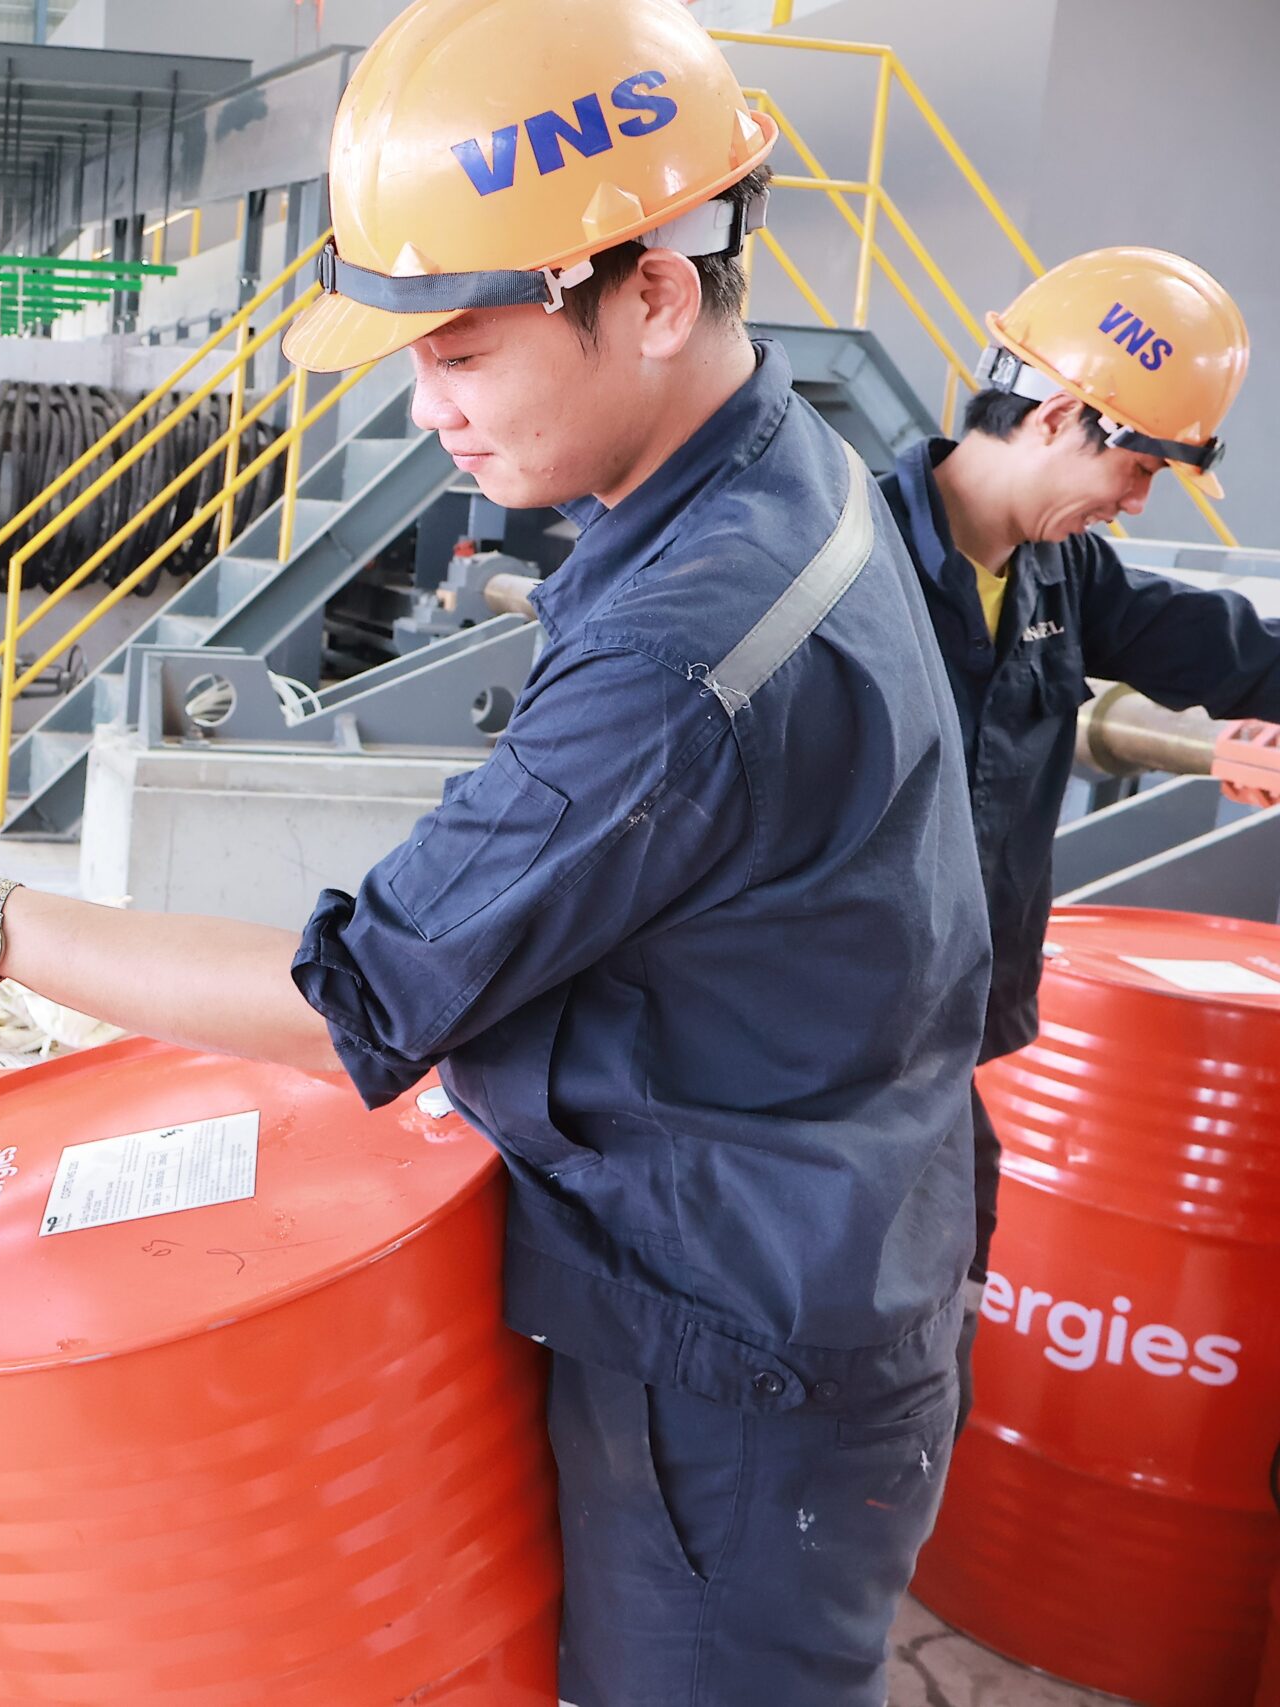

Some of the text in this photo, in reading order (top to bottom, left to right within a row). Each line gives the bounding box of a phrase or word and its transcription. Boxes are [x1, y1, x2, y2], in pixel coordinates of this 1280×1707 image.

[451, 71, 677, 196] VNS
[1098, 302, 1173, 371] VNS
[980, 1270, 1242, 1386] ergies
